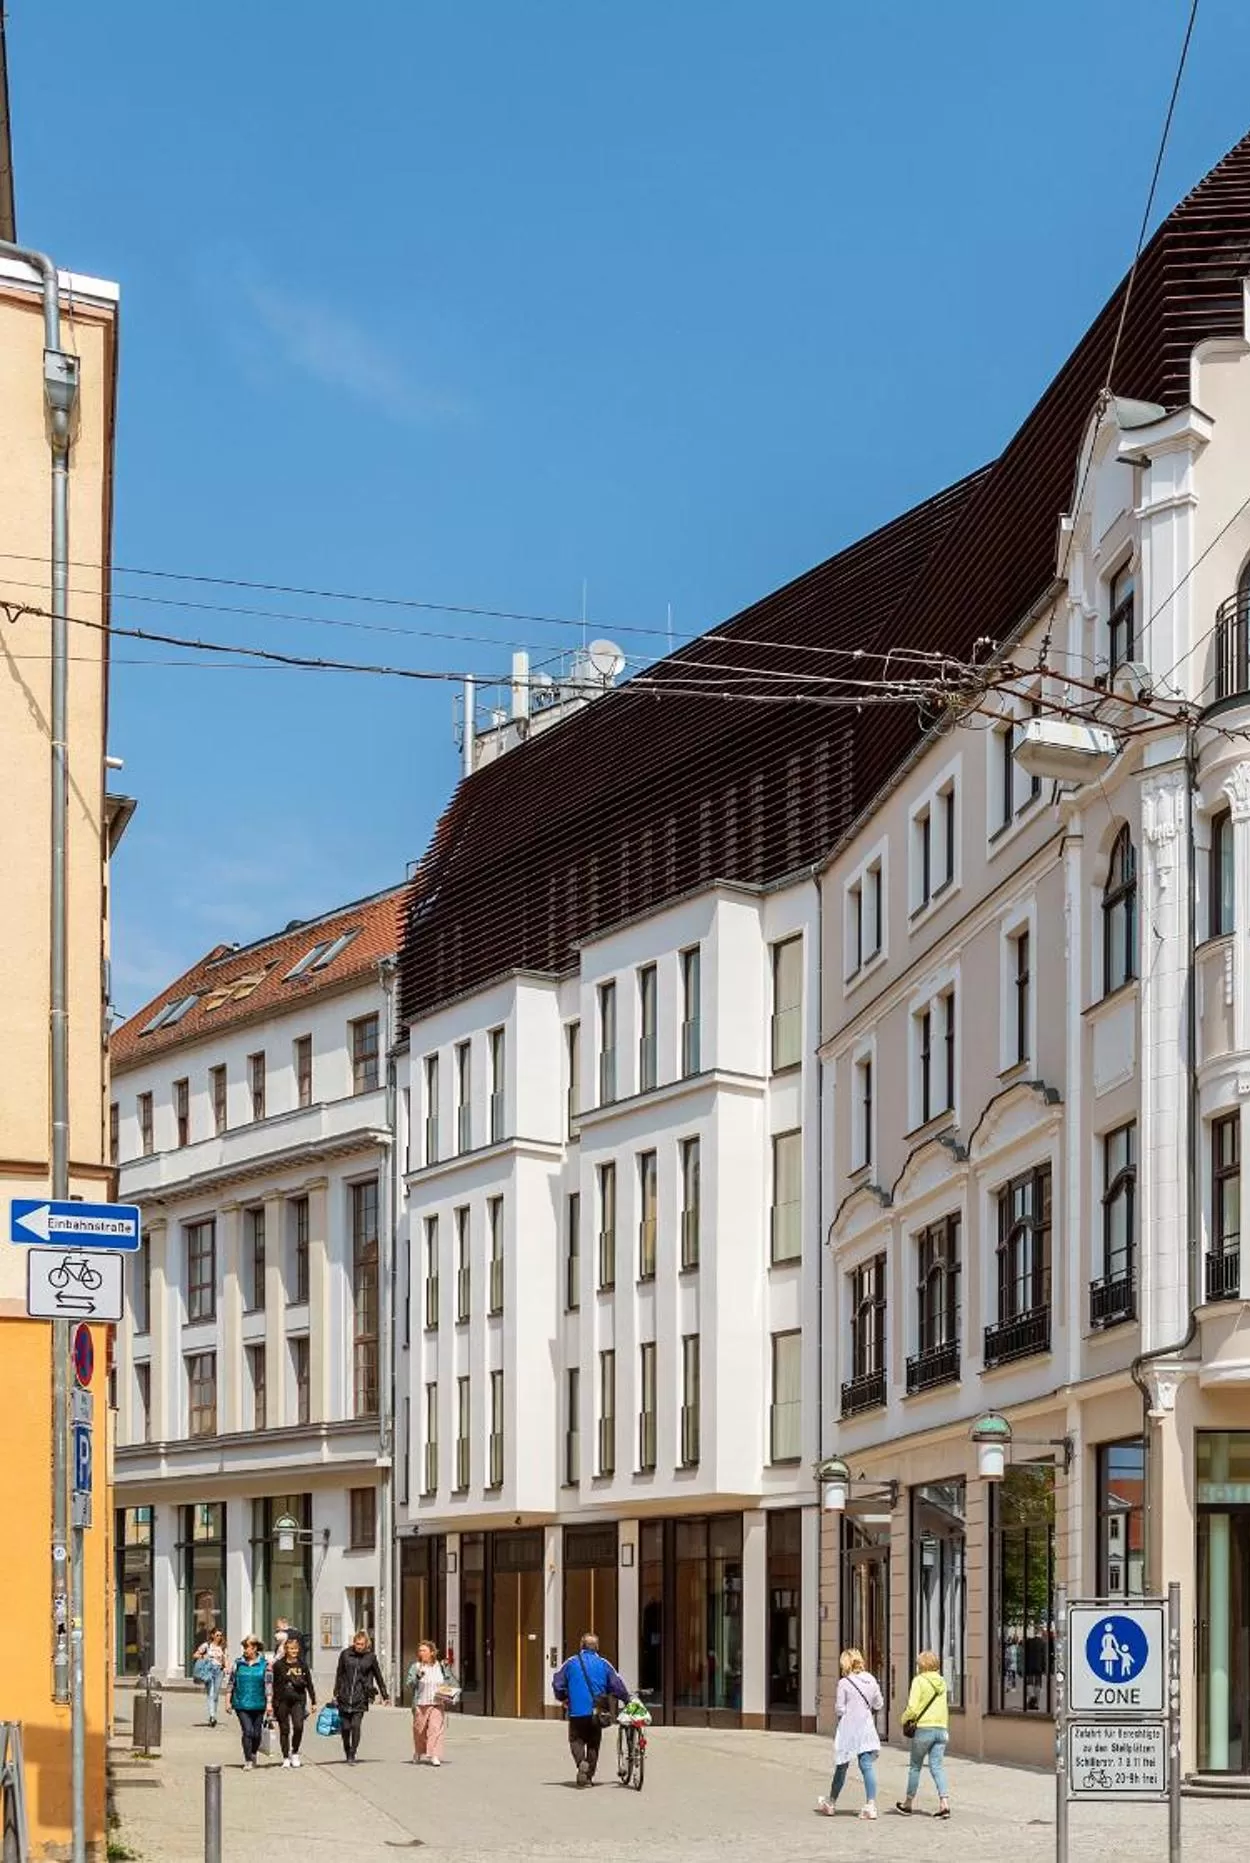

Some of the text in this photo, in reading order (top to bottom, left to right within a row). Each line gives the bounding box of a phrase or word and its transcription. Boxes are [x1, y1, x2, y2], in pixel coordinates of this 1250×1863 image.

[48, 1217, 132, 1233] Einbahnstraße
[1093, 1688, 1140, 1704] ZONE
[1074, 1728, 1160, 1740] Zufahrt für Berechtigte
[1083, 1744, 1092, 1753] zu
[1094, 1743, 1108, 1753] den
[1143, 1757, 1156, 1767] frei
[1142, 1772, 1158, 1784] frei
